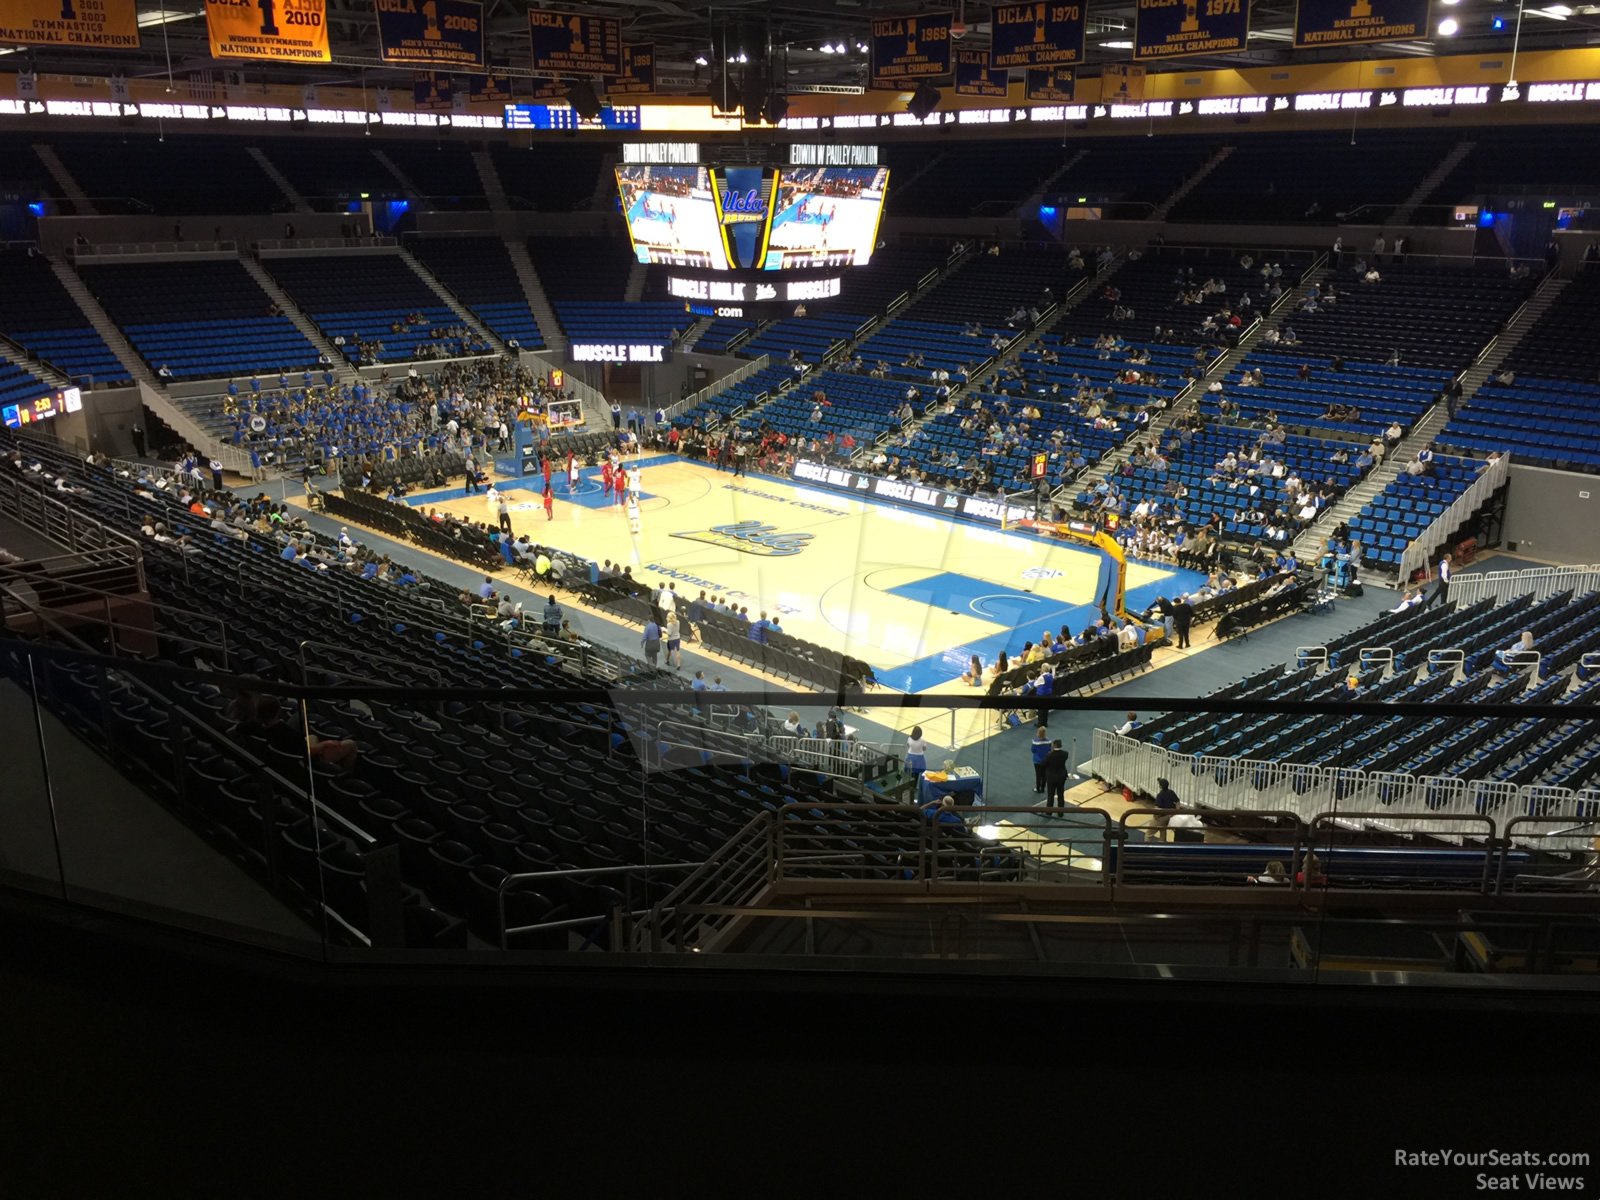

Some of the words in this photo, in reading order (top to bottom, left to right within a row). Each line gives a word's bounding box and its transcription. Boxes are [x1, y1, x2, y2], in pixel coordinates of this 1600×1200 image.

[998, 7, 1033, 24] UCLA
[1052, 6, 1079, 22] 1970
[1206, 0, 1240, 16] 1971
[32, 19, 104, 32] GYMNASTICS
[285, 10, 321, 26] 2010
[444, 15, 478, 31] 2006
[531, 12, 565, 28] UCLA
[1334, 16, 1385, 28] BASKETBALL
[0, 28, 62, 41] NATIONAL
[68, 32, 137, 45] CHAMPIONS
[874, 20, 905, 37] UCLA
[921, 27, 947, 41] 1969
[1166, 31, 1211, 42] BASKETBALL
[1304, 29, 1353, 42] NATIONAL
[1355, 24, 1416, 38] CHAMPIONS
[220, 44, 268, 55] NATIONAL
[270, 47, 323, 58] CHAMPIONS
[388, 48, 431, 57] NATIONAL
[432, 49, 476, 61] CHAMPIONS
[1014, 43, 1057, 53] BASKETBALL
[1141, 43, 1184, 55] NATIONAL
[1186, 38, 1239, 51] CHAMPIONS
[996, 53, 1030, 65] NATIONAL
[1036, 49, 1076, 62] CHAMPIONS
[791, 144, 816, 164] EDWIN
[818, 145, 825, 164] W
[826, 145, 851, 165] PAULEY
[851, 145, 878, 165] PAVILION
[573, 345, 626, 361] MUSCLE
[629, 345, 664, 361] MILK
[644, 563, 729, 591] WOODEN
